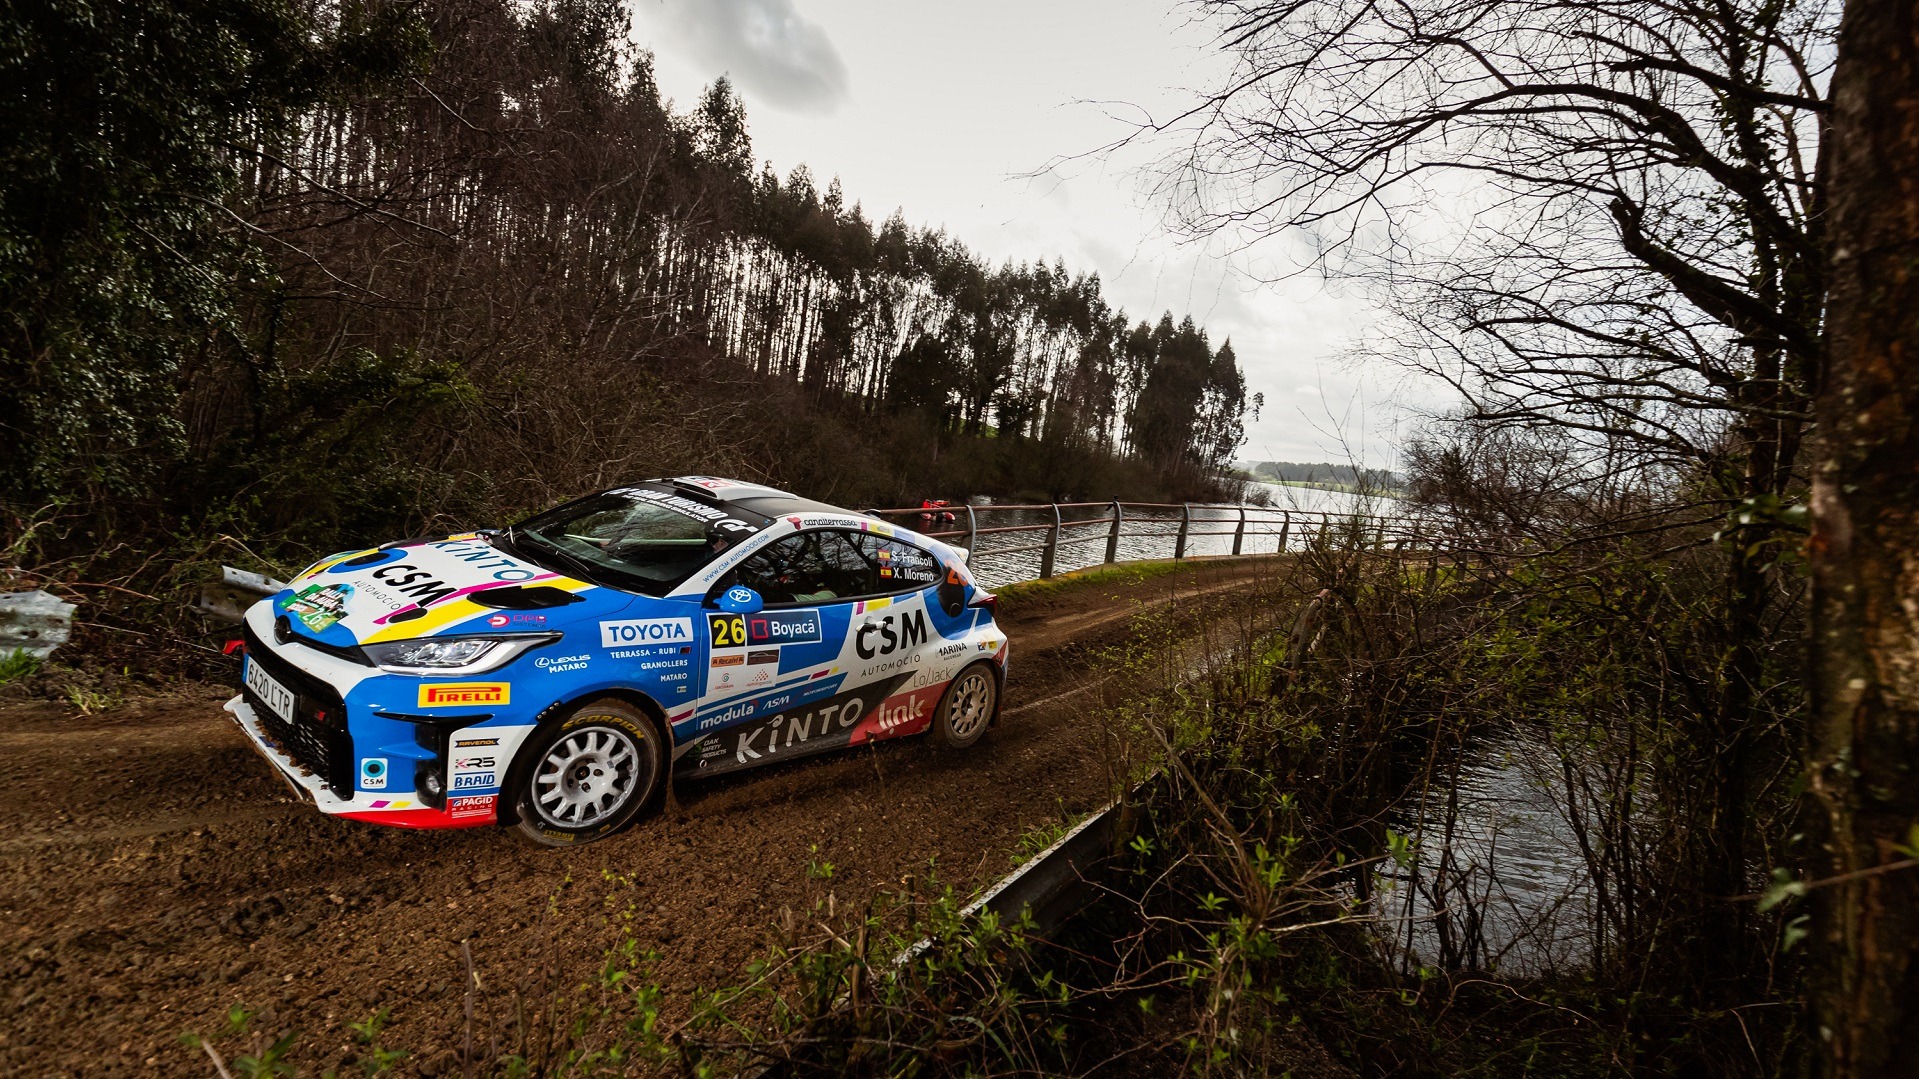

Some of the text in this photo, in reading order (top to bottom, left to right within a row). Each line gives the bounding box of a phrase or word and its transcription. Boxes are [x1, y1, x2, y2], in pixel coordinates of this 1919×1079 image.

[664, 496, 729, 519] TURISMO
[671, 505, 709, 522] SIMULATOR
[891, 551, 901, 562] S.
[893, 569, 934, 582] X. Moreno
[372, 564, 459, 608] CSM
[513, 614, 547, 624] DPB
[608, 622, 686, 642] TOYOTA
[713, 618, 745, 646] 26
[855, 608, 928, 660] CSM
[610, 649, 651, 659] TERRASSA
[658, 647, 677, 656] RUBI
[935, 642, 968, 658] MARINA
[550, 654, 591, 664] LEXUS
[641, 659, 689, 670] GRANOLLERS
[860, 652, 921, 678] AUTOMOCIÓ
[548, 662, 588, 674] MATARO
[660, 672, 688, 682] MATARO
[248, 663, 291, 718] 6420 LTR
[427, 686, 502, 703] PIRELLI
[762, 694, 791, 711] ASM
[700, 703, 755, 730] modula
[878, 694, 926, 735] link
[561, 714, 645, 740] SCORPION
[458, 739, 496, 747] RAVENOL
[701, 743, 722, 753] SAFETY
[703, 737, 720, 747] OAK
[454, 774, 495, 788] BRAID
[462, 796, 494, 807] PAGID
